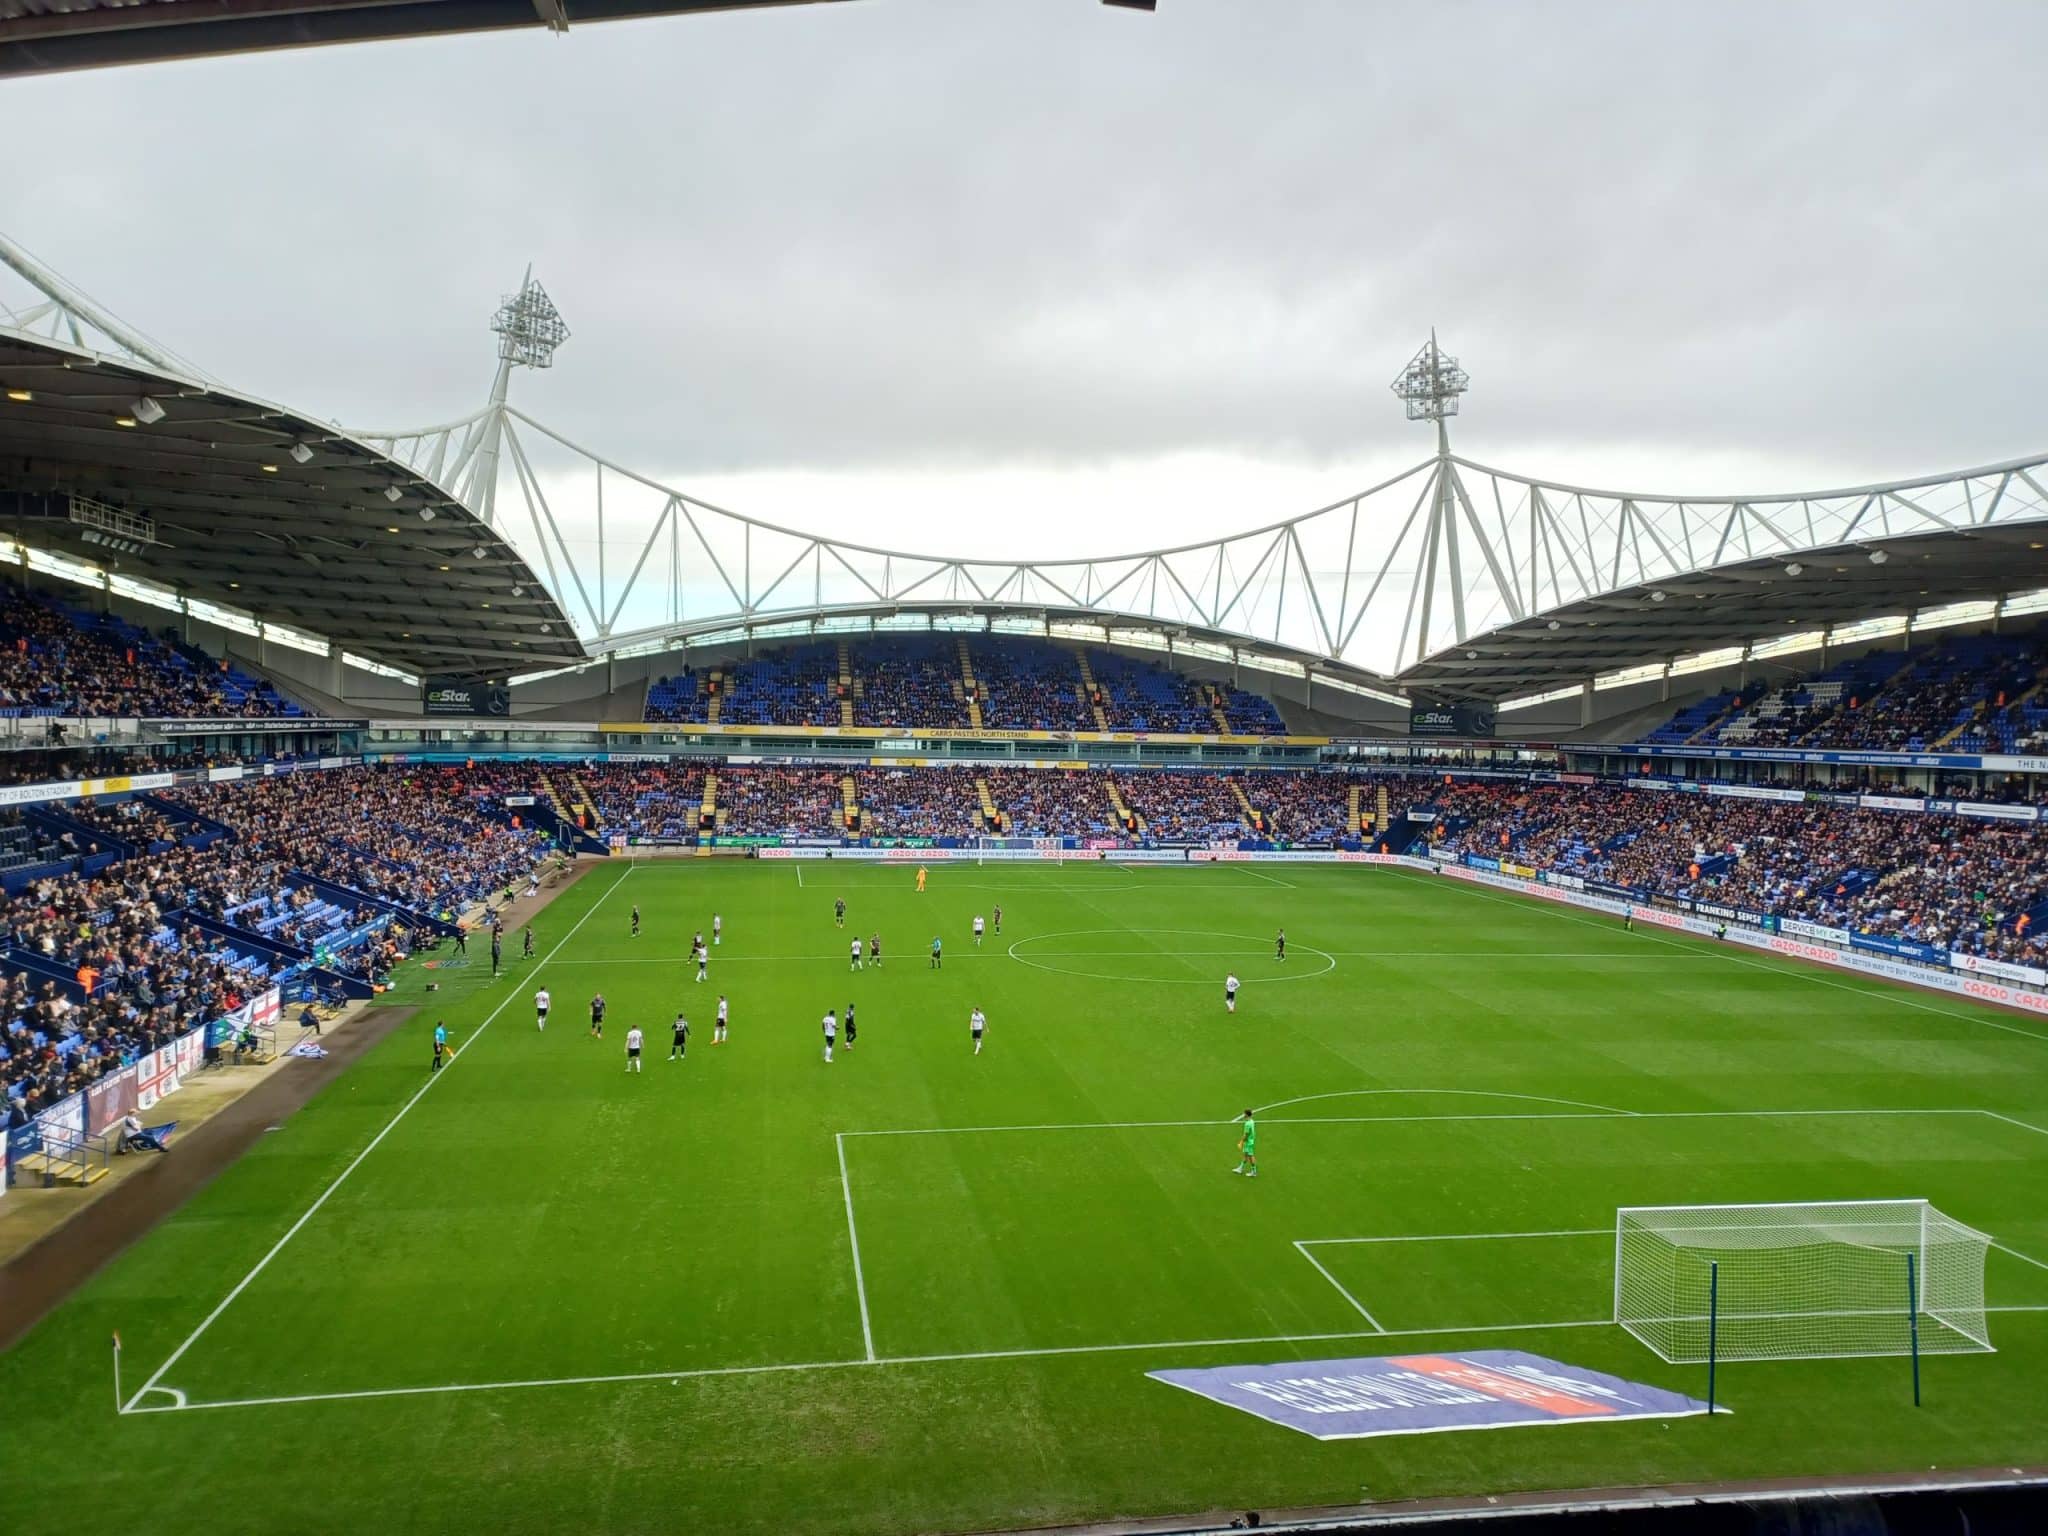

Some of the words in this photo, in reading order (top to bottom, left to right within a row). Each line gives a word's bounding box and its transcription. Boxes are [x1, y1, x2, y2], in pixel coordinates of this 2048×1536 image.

[930, 730, 952, 738] CARRS
[981, 731, 1005, 739] NORTH
[1006, 731, 1029, 739] STAND
[2018, 760, 2034, 768] THE
[2040, 760, 2048, 769] N
[20, 788, 46, 799] BOLTON
[47, 785, 72, 797] STADIUM
[1696, 903, 1735, 919] FRANKING
[1737, 911, 1761, 924] SENSE
[1783, 920, 1815, 935] SERVICE
[1771, 940, 1801, 953] CAZOO
[1805, 947, 1838, 961] CAZOO
[1908, 970, 1925, 980] YOUR
[1926, 973, 1942, 984] NEXT
[1963, 980, 2008, 1000] CAZOO
